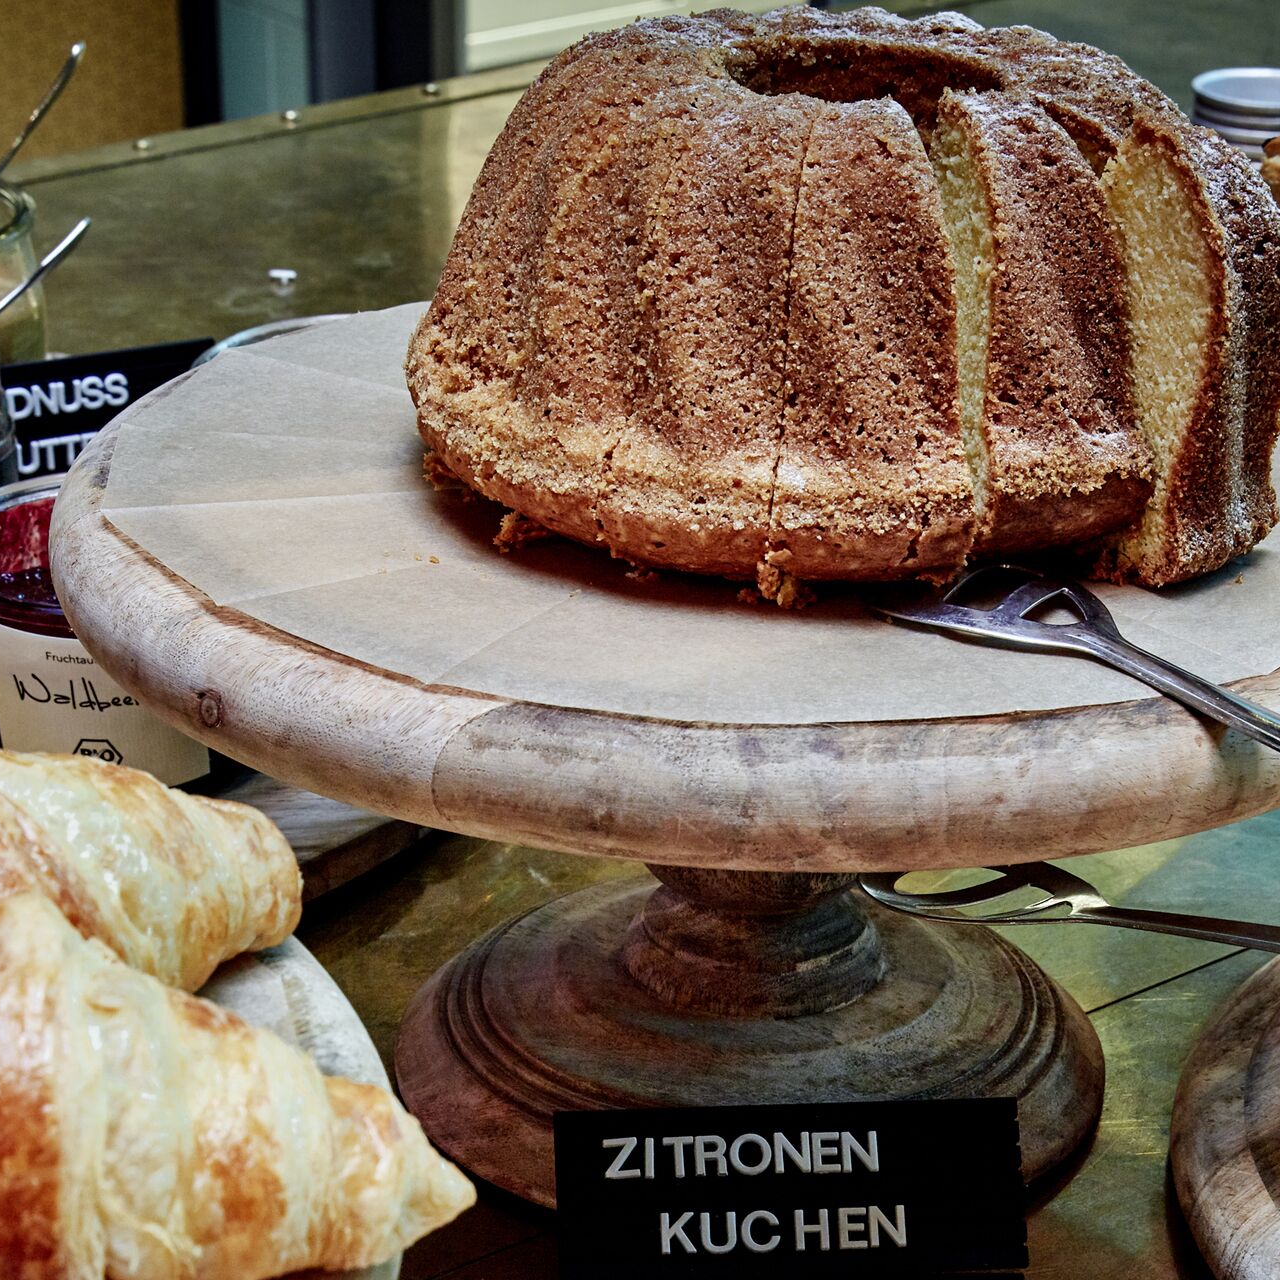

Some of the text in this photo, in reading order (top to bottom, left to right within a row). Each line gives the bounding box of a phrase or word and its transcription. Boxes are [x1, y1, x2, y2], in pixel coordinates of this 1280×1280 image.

[45, 651, 97, 666] Fruchtau
[602, 1130, 880, 1180] ZITRONEN
[659, 1204, 908, 1256] KUCHEN
